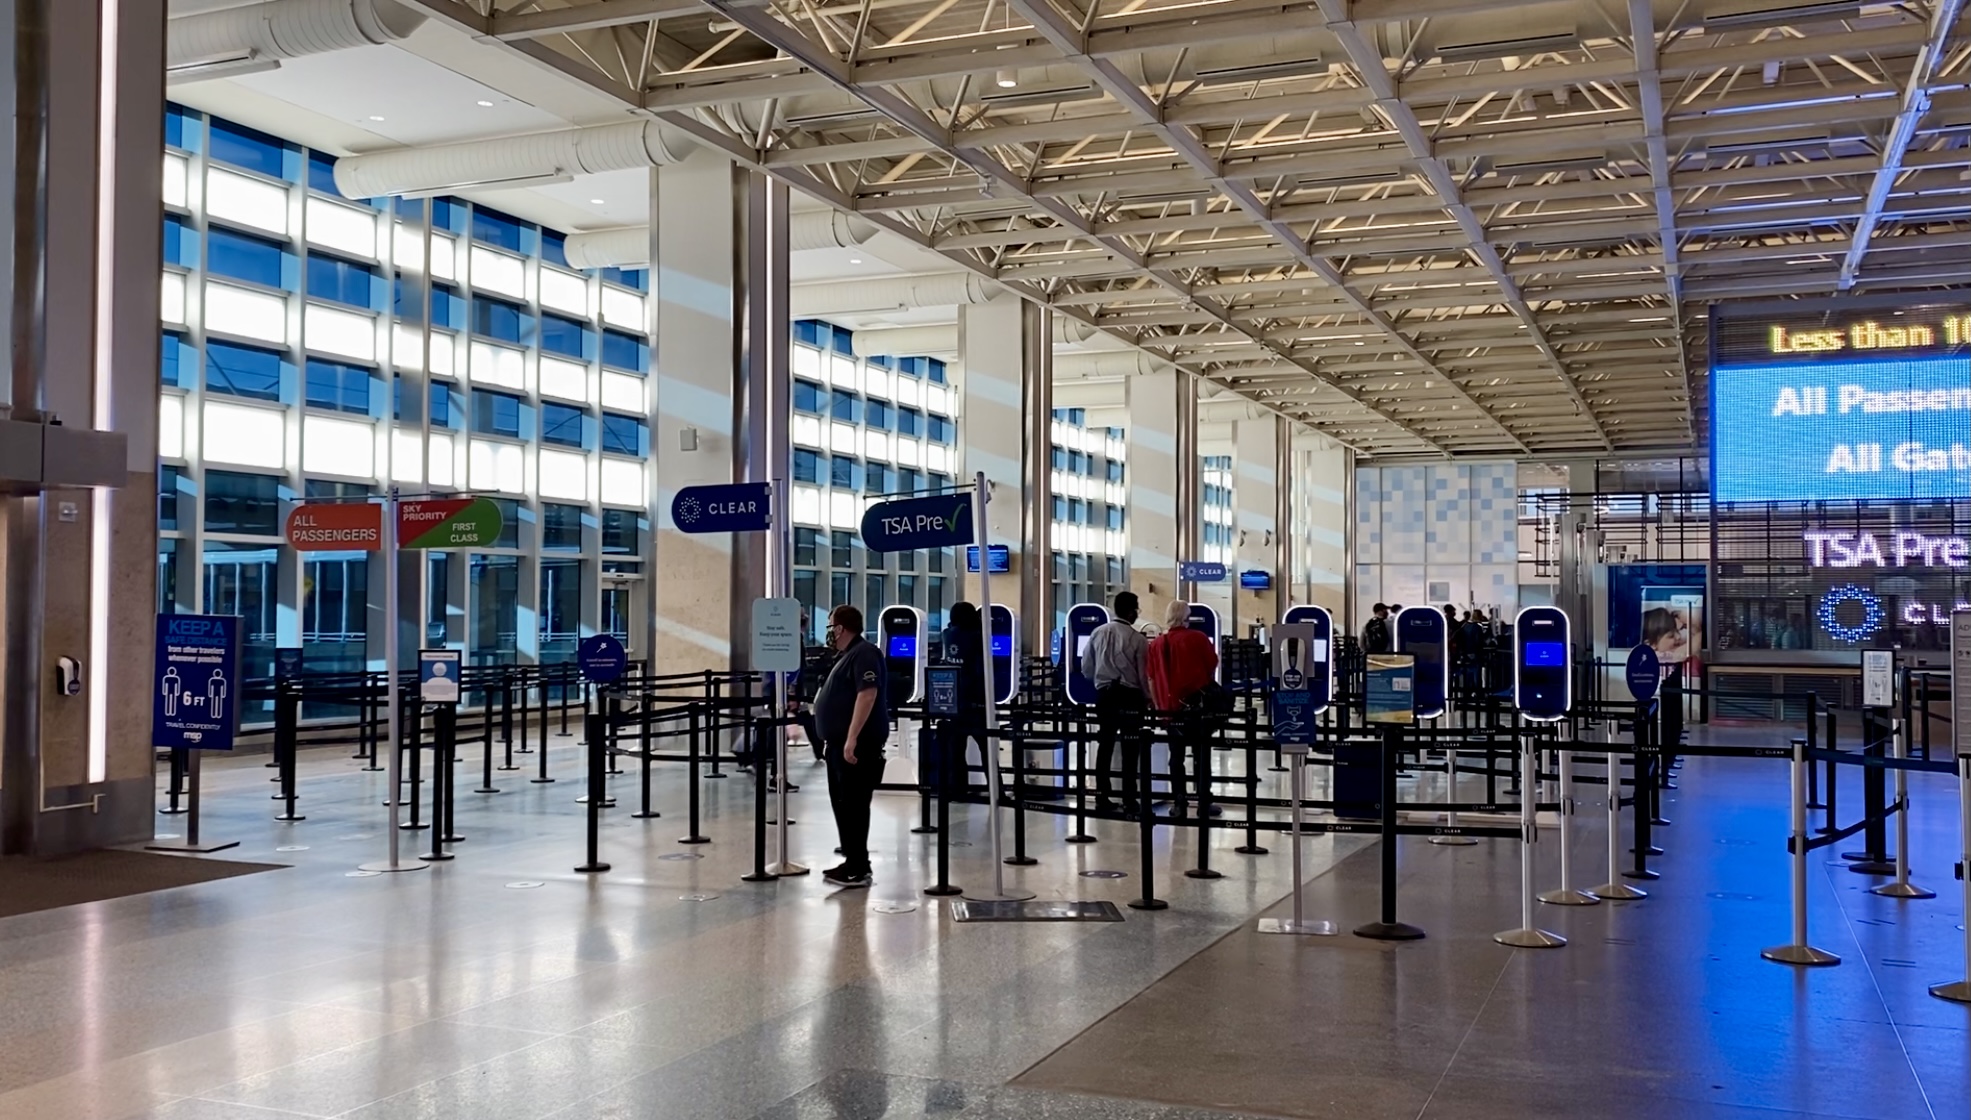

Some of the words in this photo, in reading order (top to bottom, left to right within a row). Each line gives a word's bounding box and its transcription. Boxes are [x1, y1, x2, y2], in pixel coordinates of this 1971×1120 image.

[1772, 325, 1845, 352] Less
[1852, 321, 1935, 349] than
[1774, 386, 1827, 416] All
[1826, 443, 1882, 473] All
[1892, 442, 1971, 472] Gat
[403, 504, 421, 513] SKY
[708, 501, 756, 515] CLEAR
[293, 515, 317, 527] ALL
[403, 511, 447, 521] PRIORITY
[452, 522, 476, 531] FIRST
[881, 515, 912, 535] TSA
[916, 514, 943, 533] Pre
[292, 528, 377, 542] PASSENGERS
[450, 533, 478, 543] CLASS
[1804, 533, 1885, 567] TSA
[1897, 532, 1970, 567] Pre
[168, 619, 211, 635] KEEP
[212, 621, 225, 636] A
[187, 636, 228, 646] DISTANCE
[182, 690, 192, 706] 6
[193, 697, 205, 706] FT
